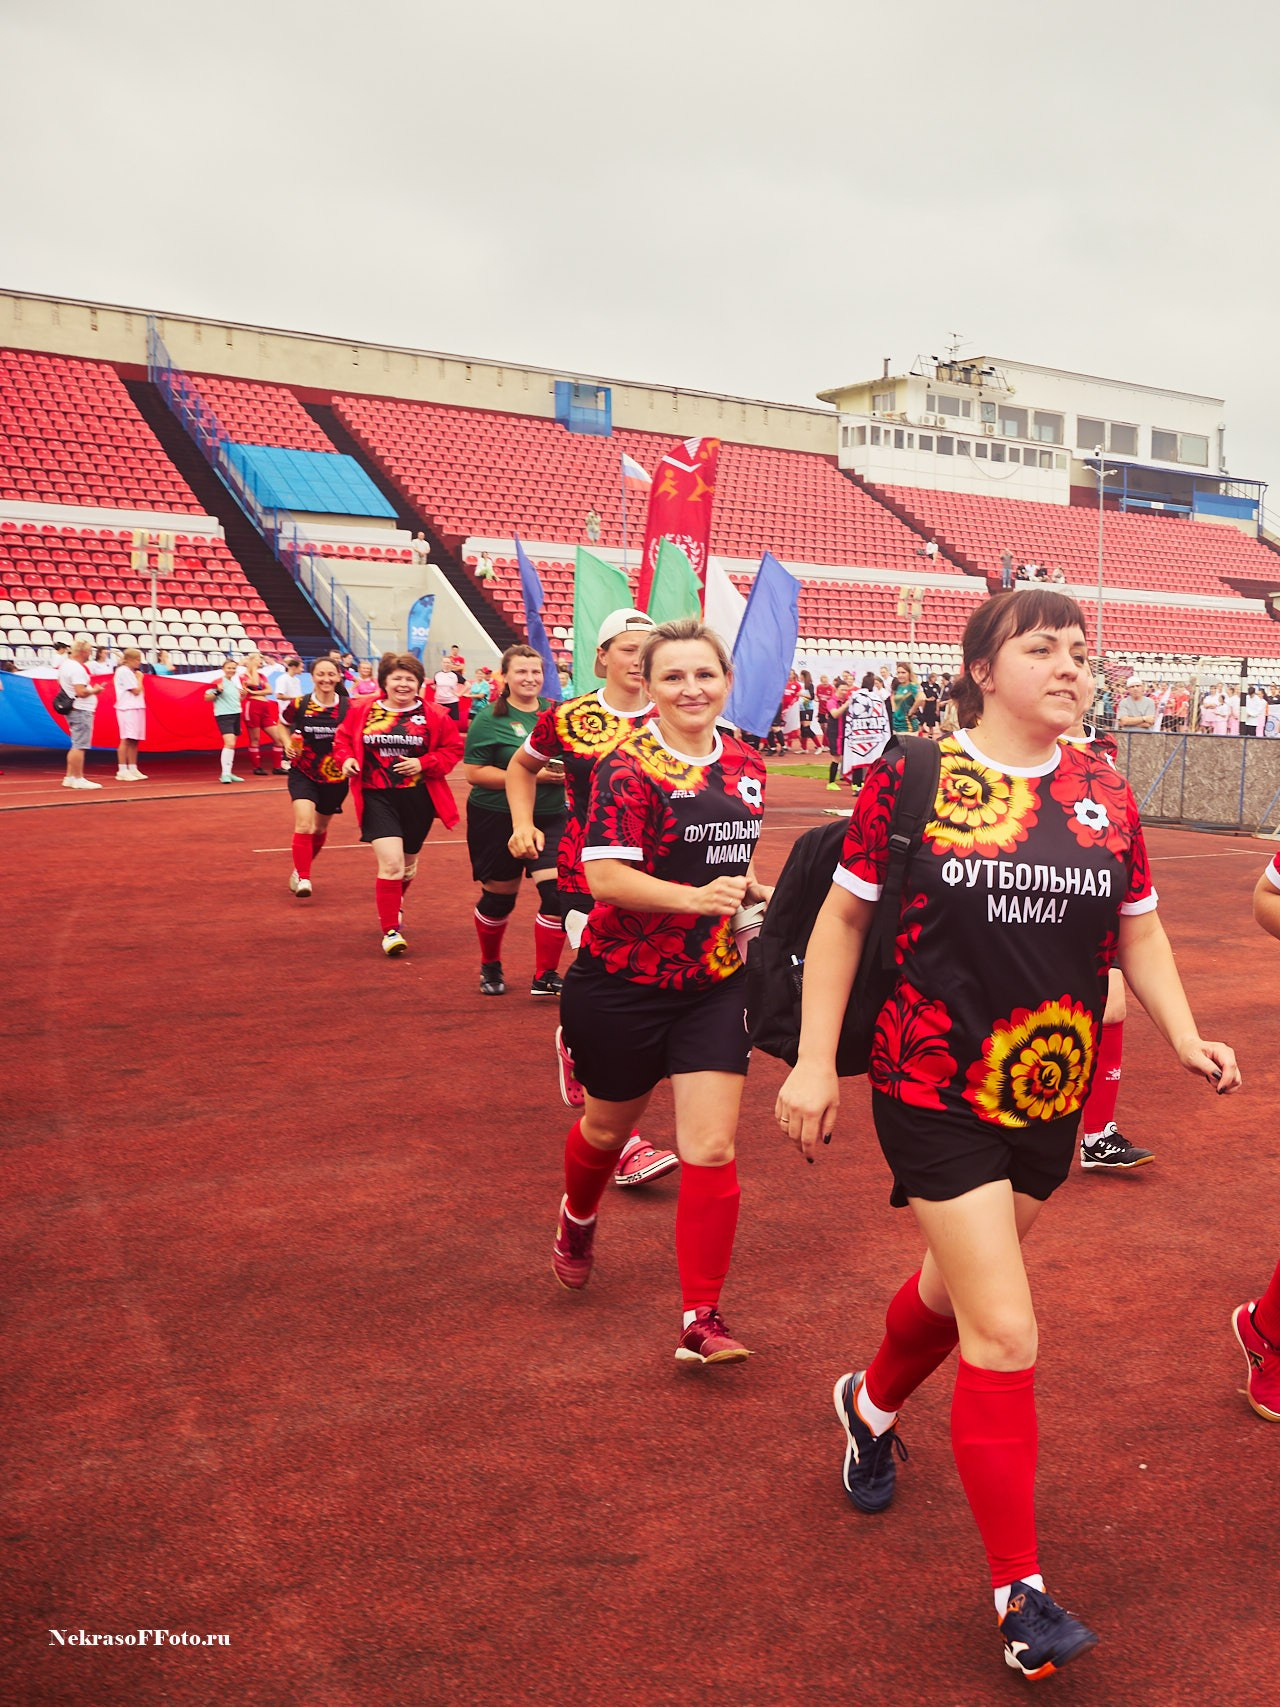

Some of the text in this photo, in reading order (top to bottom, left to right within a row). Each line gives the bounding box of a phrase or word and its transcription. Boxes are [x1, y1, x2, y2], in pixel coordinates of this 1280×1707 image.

[705, 843, 752, 865] МАМА!
[941, 857, 1112, 898] ФУТБОЛЬНАЯ
[987, 894, 1069, 924] МАМА!
